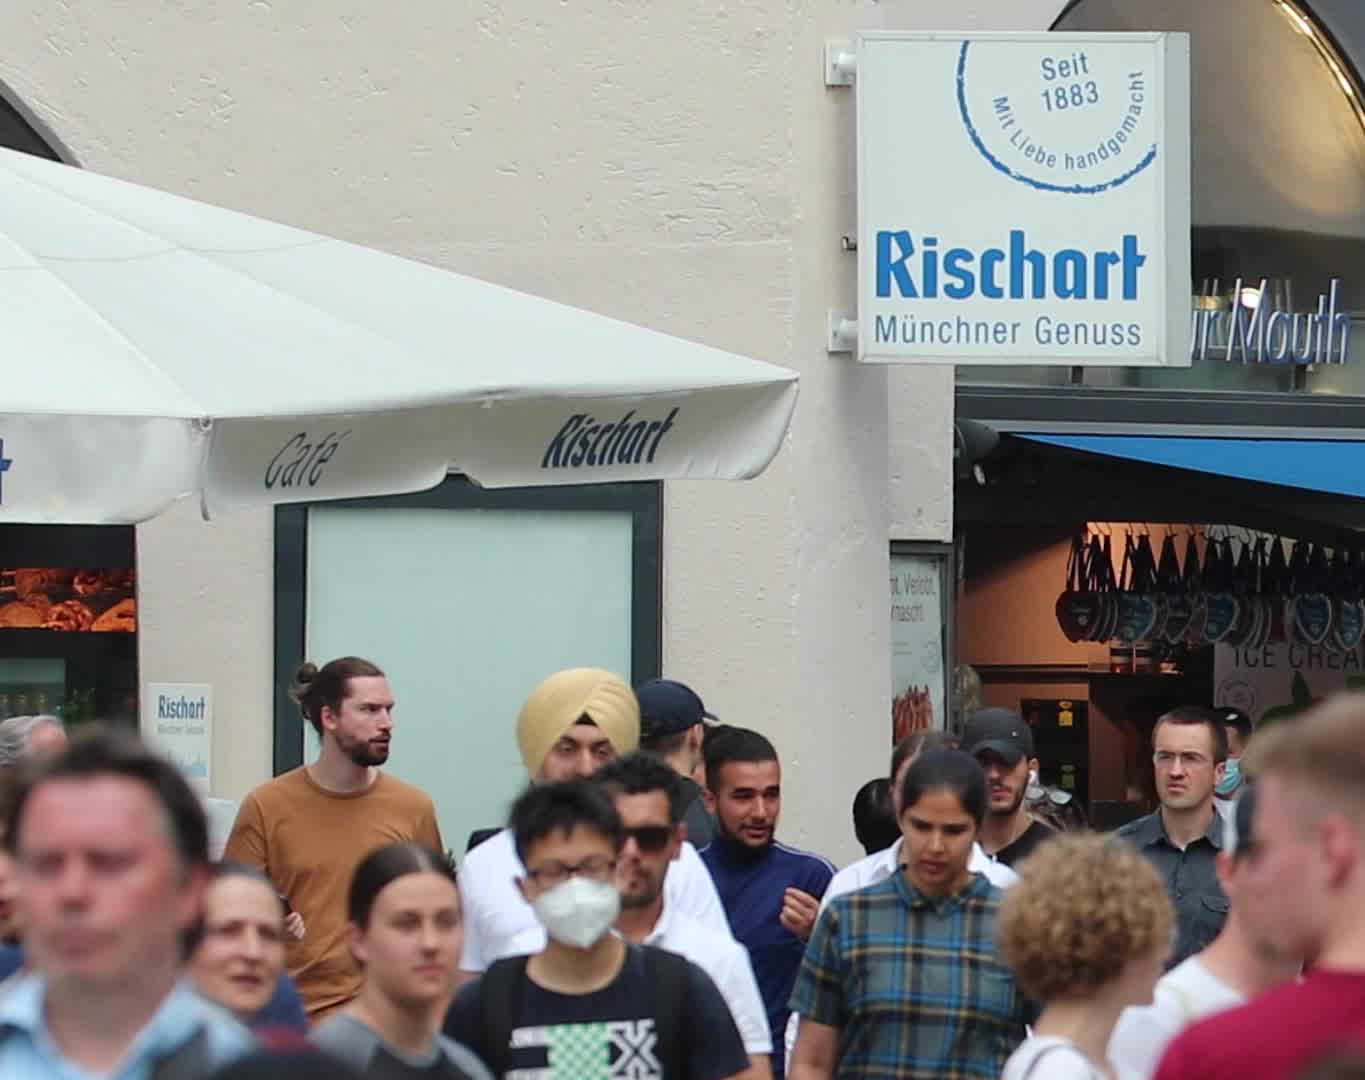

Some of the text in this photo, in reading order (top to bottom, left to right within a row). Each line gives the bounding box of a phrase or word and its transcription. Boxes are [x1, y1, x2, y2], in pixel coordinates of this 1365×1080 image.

[1041, 52, 1089, 81] Seit
[1041, 81, 1099, 112] 1883
[993, 71, 1145, 169] Mit Liebe handgemacht
[875, 230, 1147, 300] Rischart
[874, 314, 1141, 346] Münchner Genuss
[1226, 277, 1351, 365] Mouth
[264, 407, 680, 489] Café Rischart
[1235, 645, 1275, 669] ICE
[158, 694, 206, 720] Rischart
